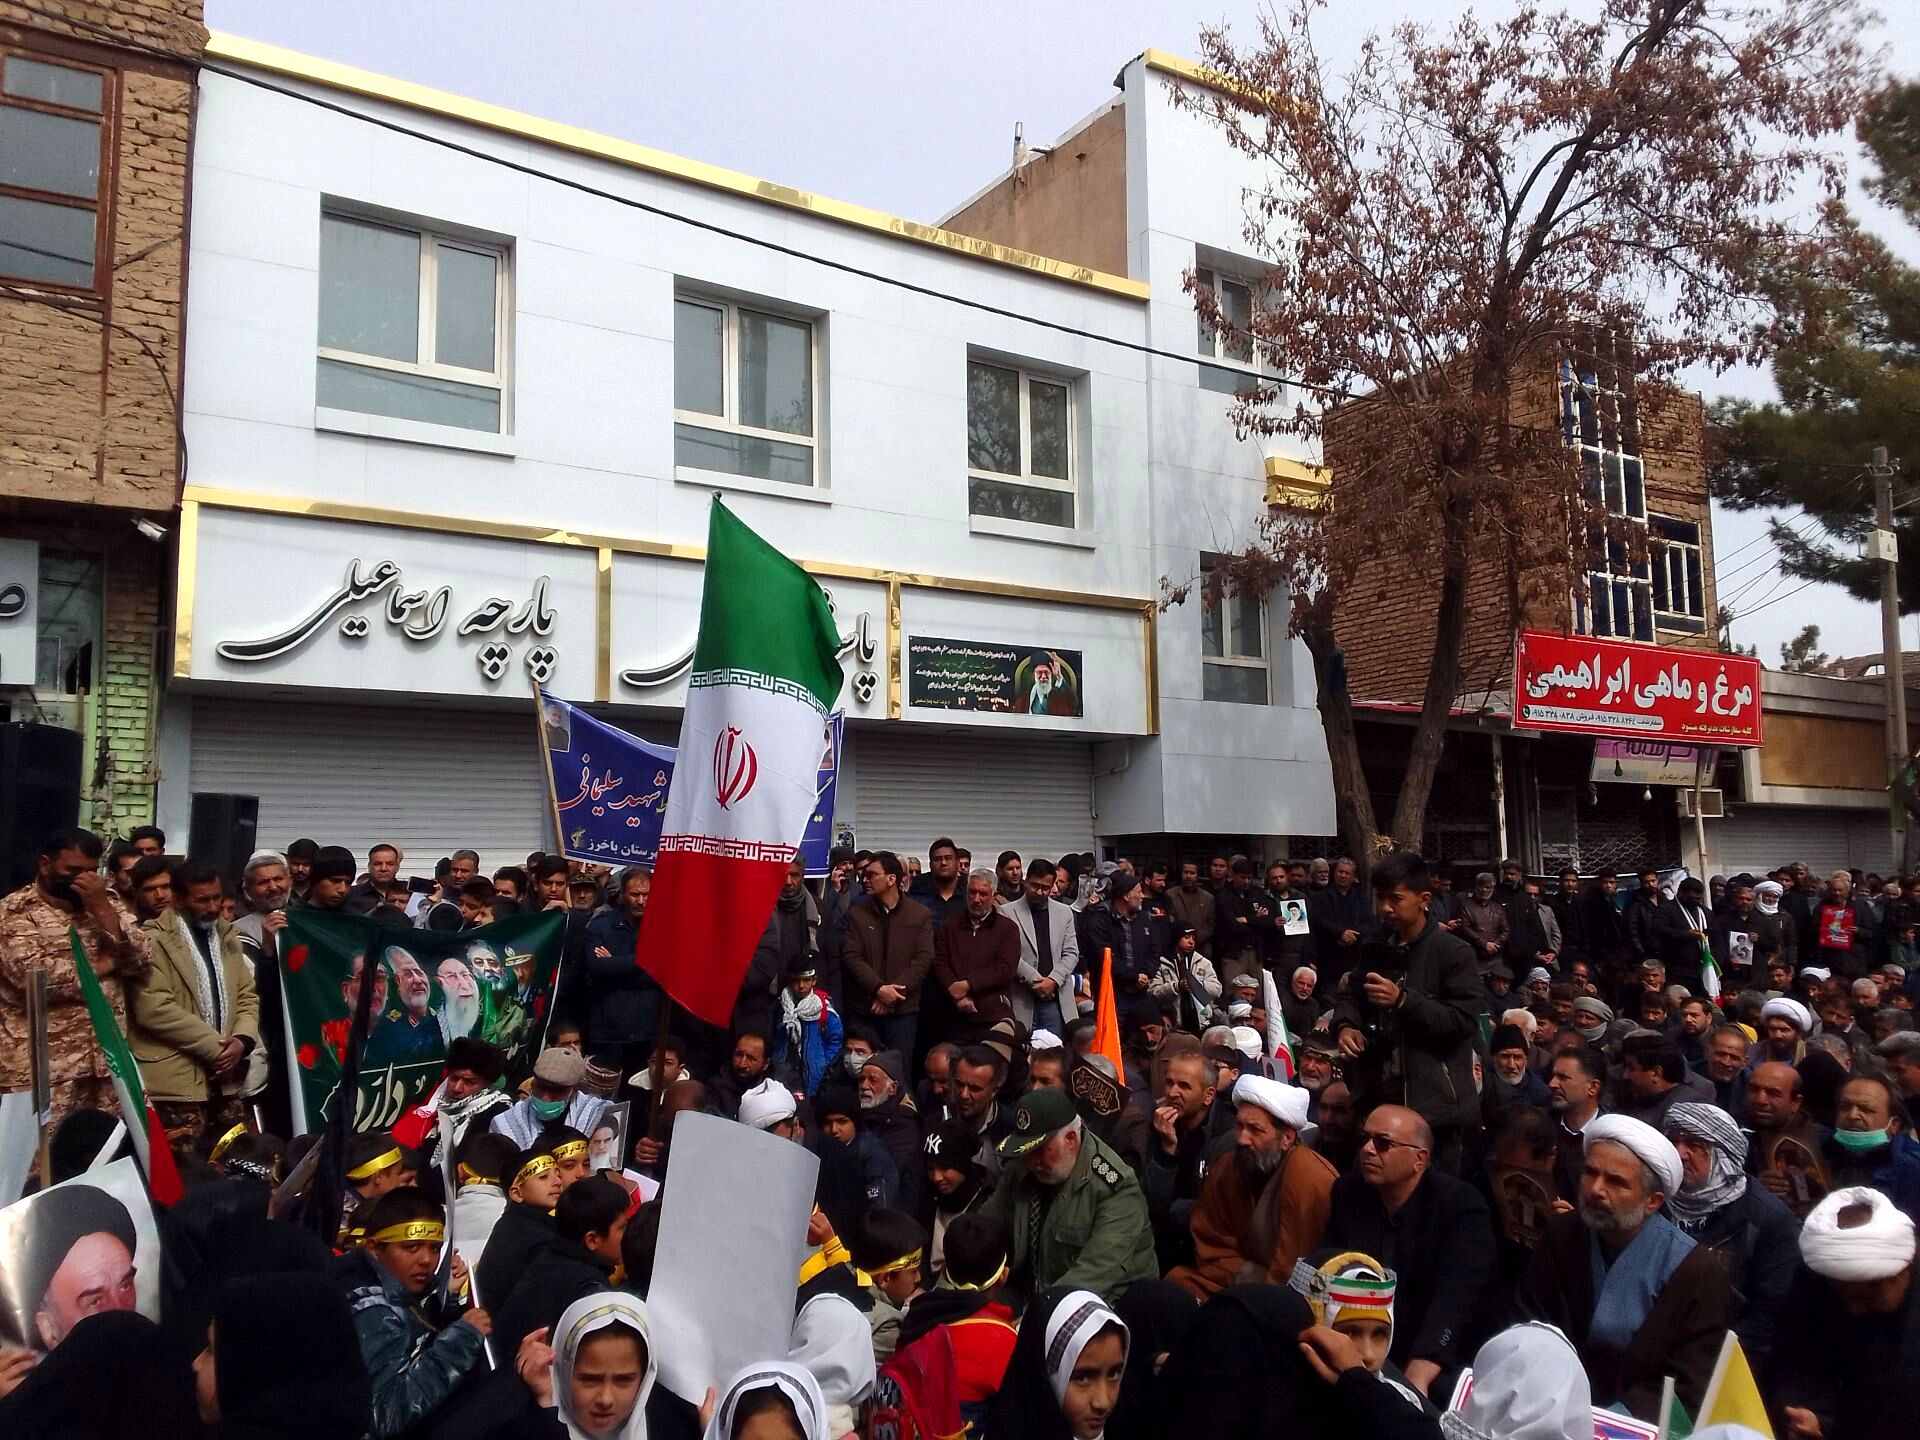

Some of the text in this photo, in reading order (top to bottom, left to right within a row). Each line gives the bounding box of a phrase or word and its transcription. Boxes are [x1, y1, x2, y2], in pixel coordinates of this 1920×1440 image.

[216, 557, 453, 661] اسماعیلی
[457, 575, 559, 683] پارچه
[1526, 652, 1753, 716] مرغ و ماهی ابراهیمی
[1576, 712, 1595, 722] فروش
[557, 753, 668, 828] شهید سلیمانی
[587, 837, 658, 860] رستان باخرز
[409, 1224, 438, 1237] اسرائیل
